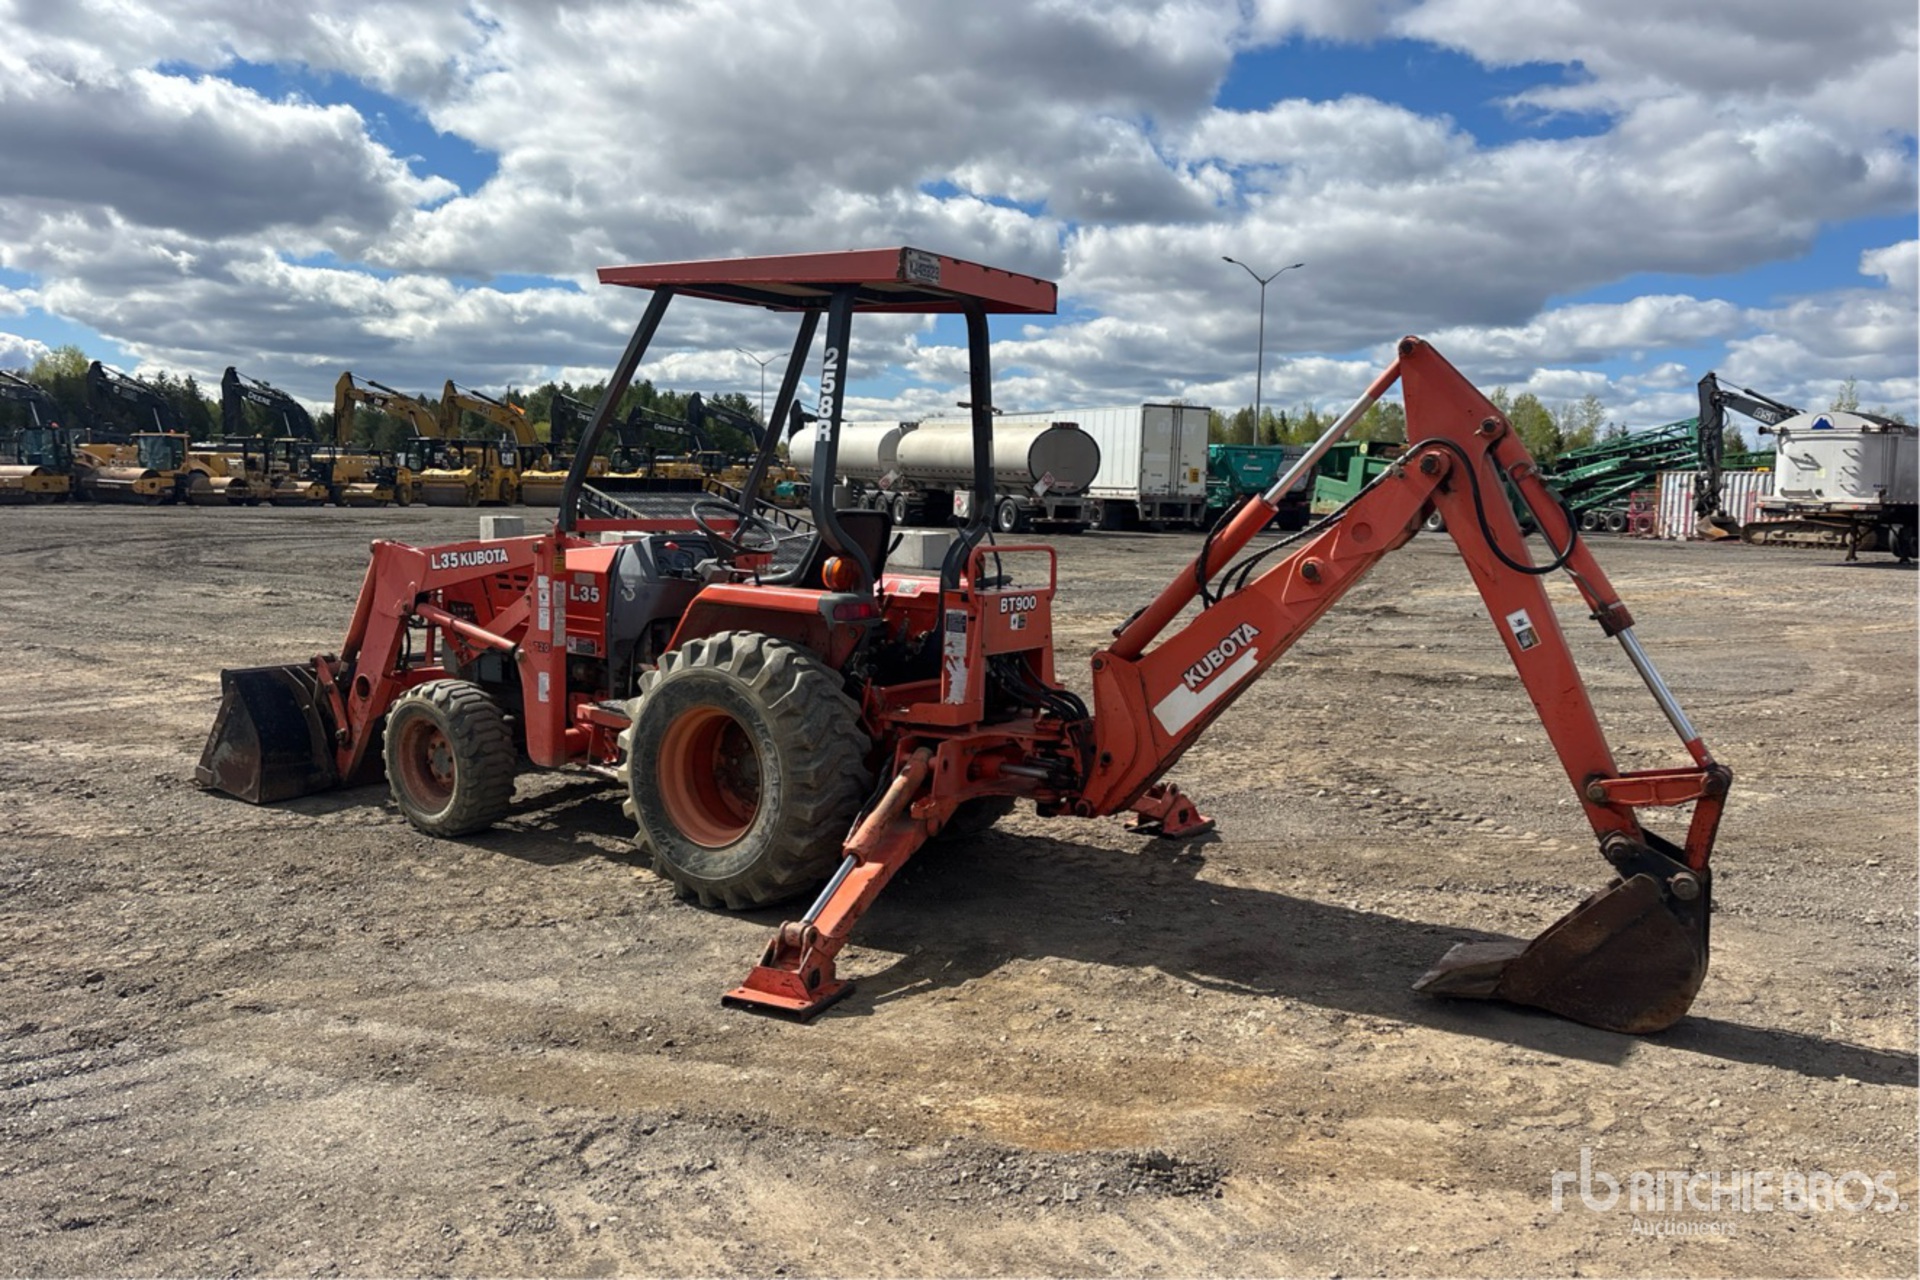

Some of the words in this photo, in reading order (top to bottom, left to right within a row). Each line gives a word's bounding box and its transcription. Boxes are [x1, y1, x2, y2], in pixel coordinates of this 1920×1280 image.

[247, 391, 271, 406] DEERE
[815, 347, 839, 442] 258R
[431, 552, 459, 570] L35
[460, 548, 509, 567] KUBOTA
[569, 584, 600, 603] L35
[999, 595, 1037, 614] BT900
[1182, 623, 1261, 689] KUBOTA
